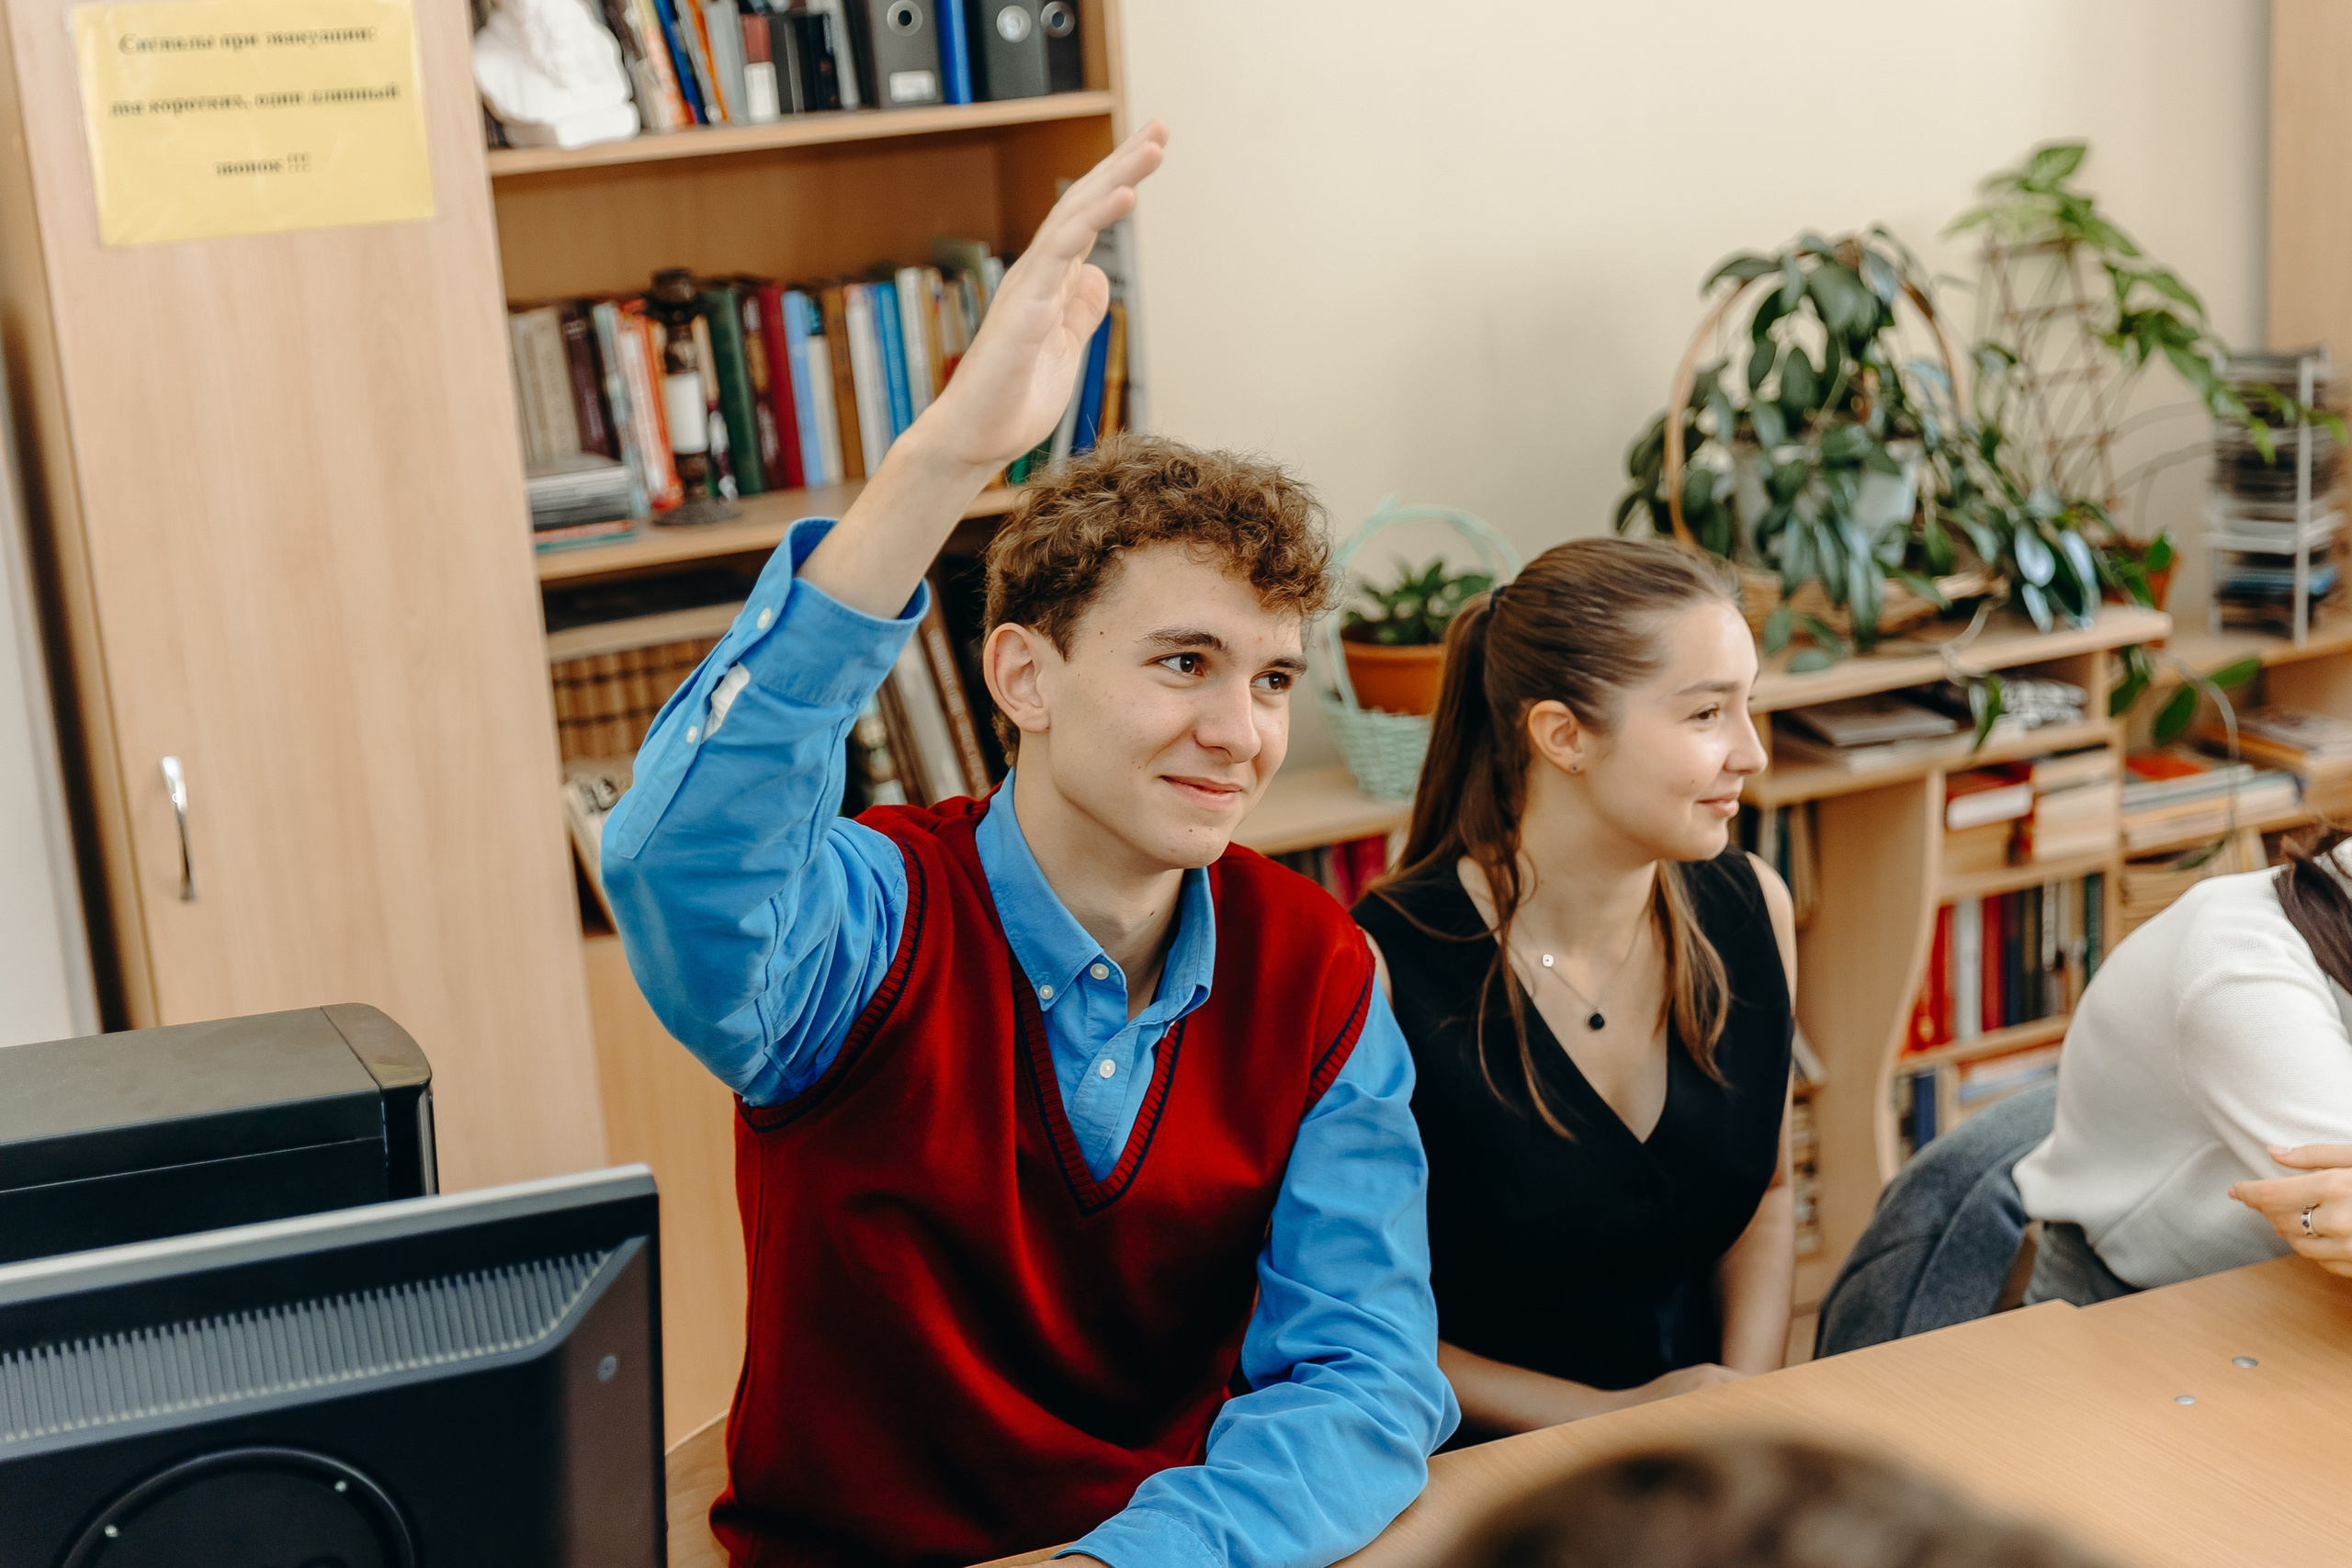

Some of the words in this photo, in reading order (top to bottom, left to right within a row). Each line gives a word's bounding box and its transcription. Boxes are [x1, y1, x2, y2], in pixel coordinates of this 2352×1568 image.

[219, 31, 258, 53] при
[254, 91, 300, 107] один
[307, 81, 400, 104] длинный
